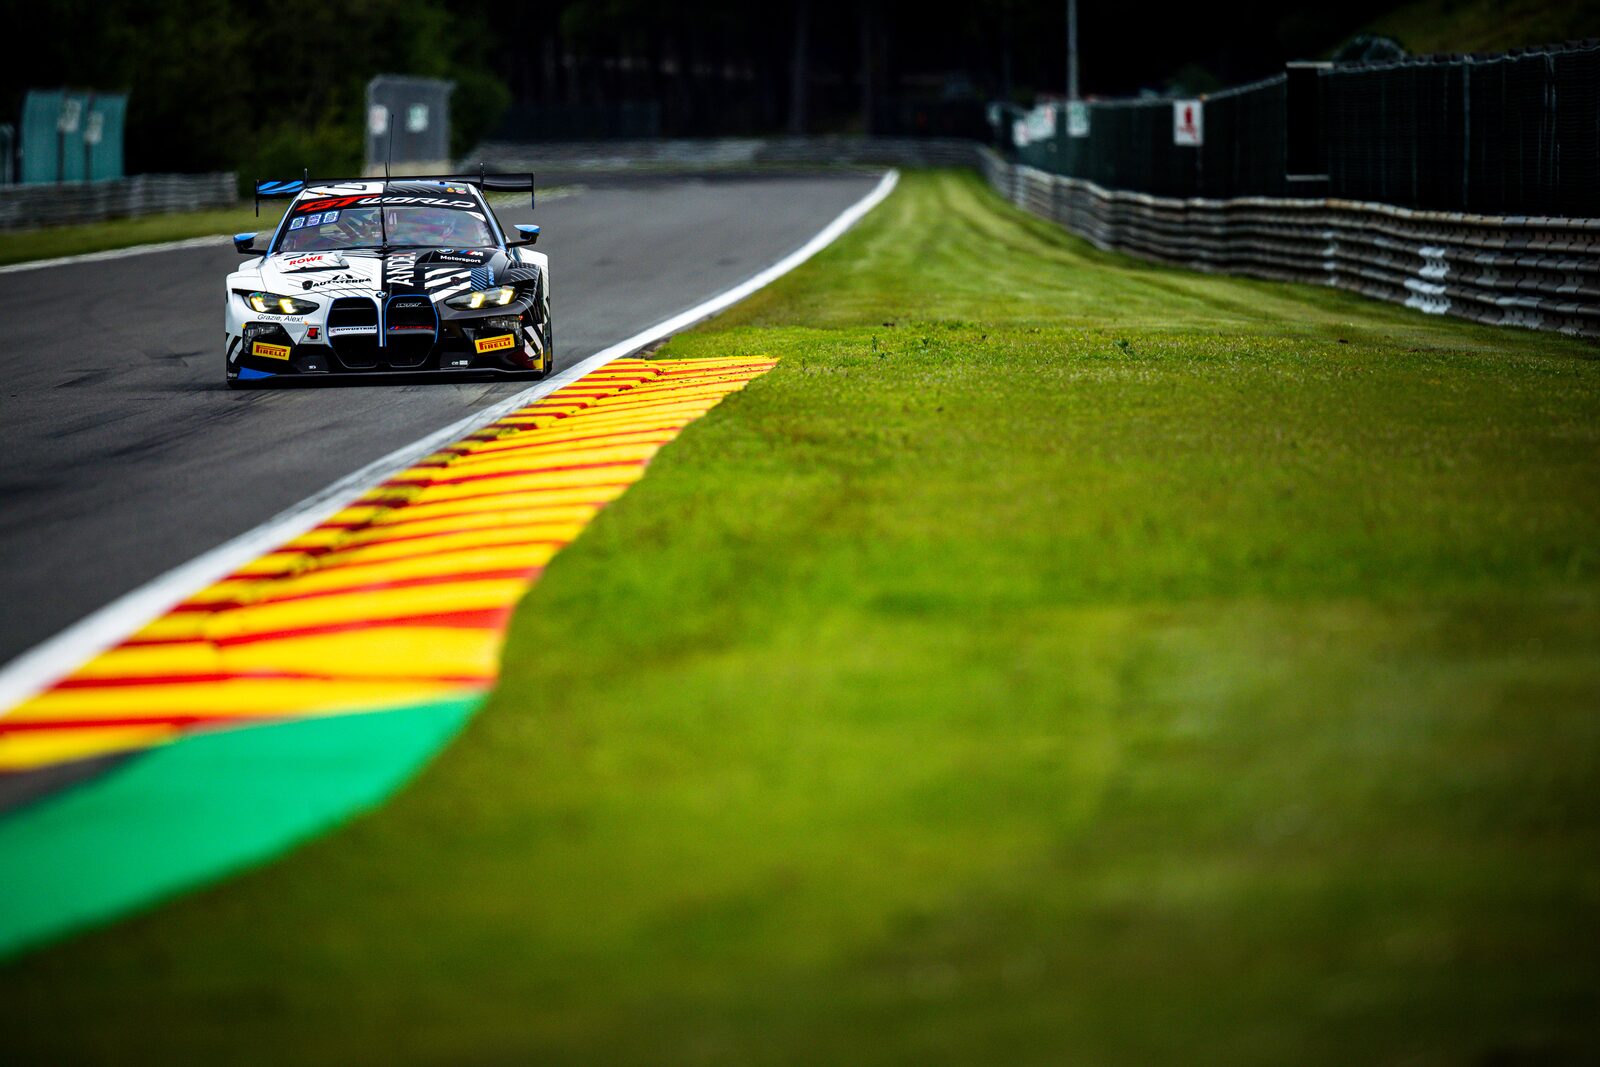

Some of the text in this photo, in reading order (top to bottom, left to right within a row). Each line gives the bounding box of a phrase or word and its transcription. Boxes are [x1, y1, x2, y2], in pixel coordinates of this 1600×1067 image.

[289, 255, 323, 266] ROWE
[440, 255, 482, 264] Motorsport
[257, 314, 304, 323] Grazie, Alex!
[479, 337, 511, 350] PIRELLI
[256, 344, 287, 357] PIRELLI
